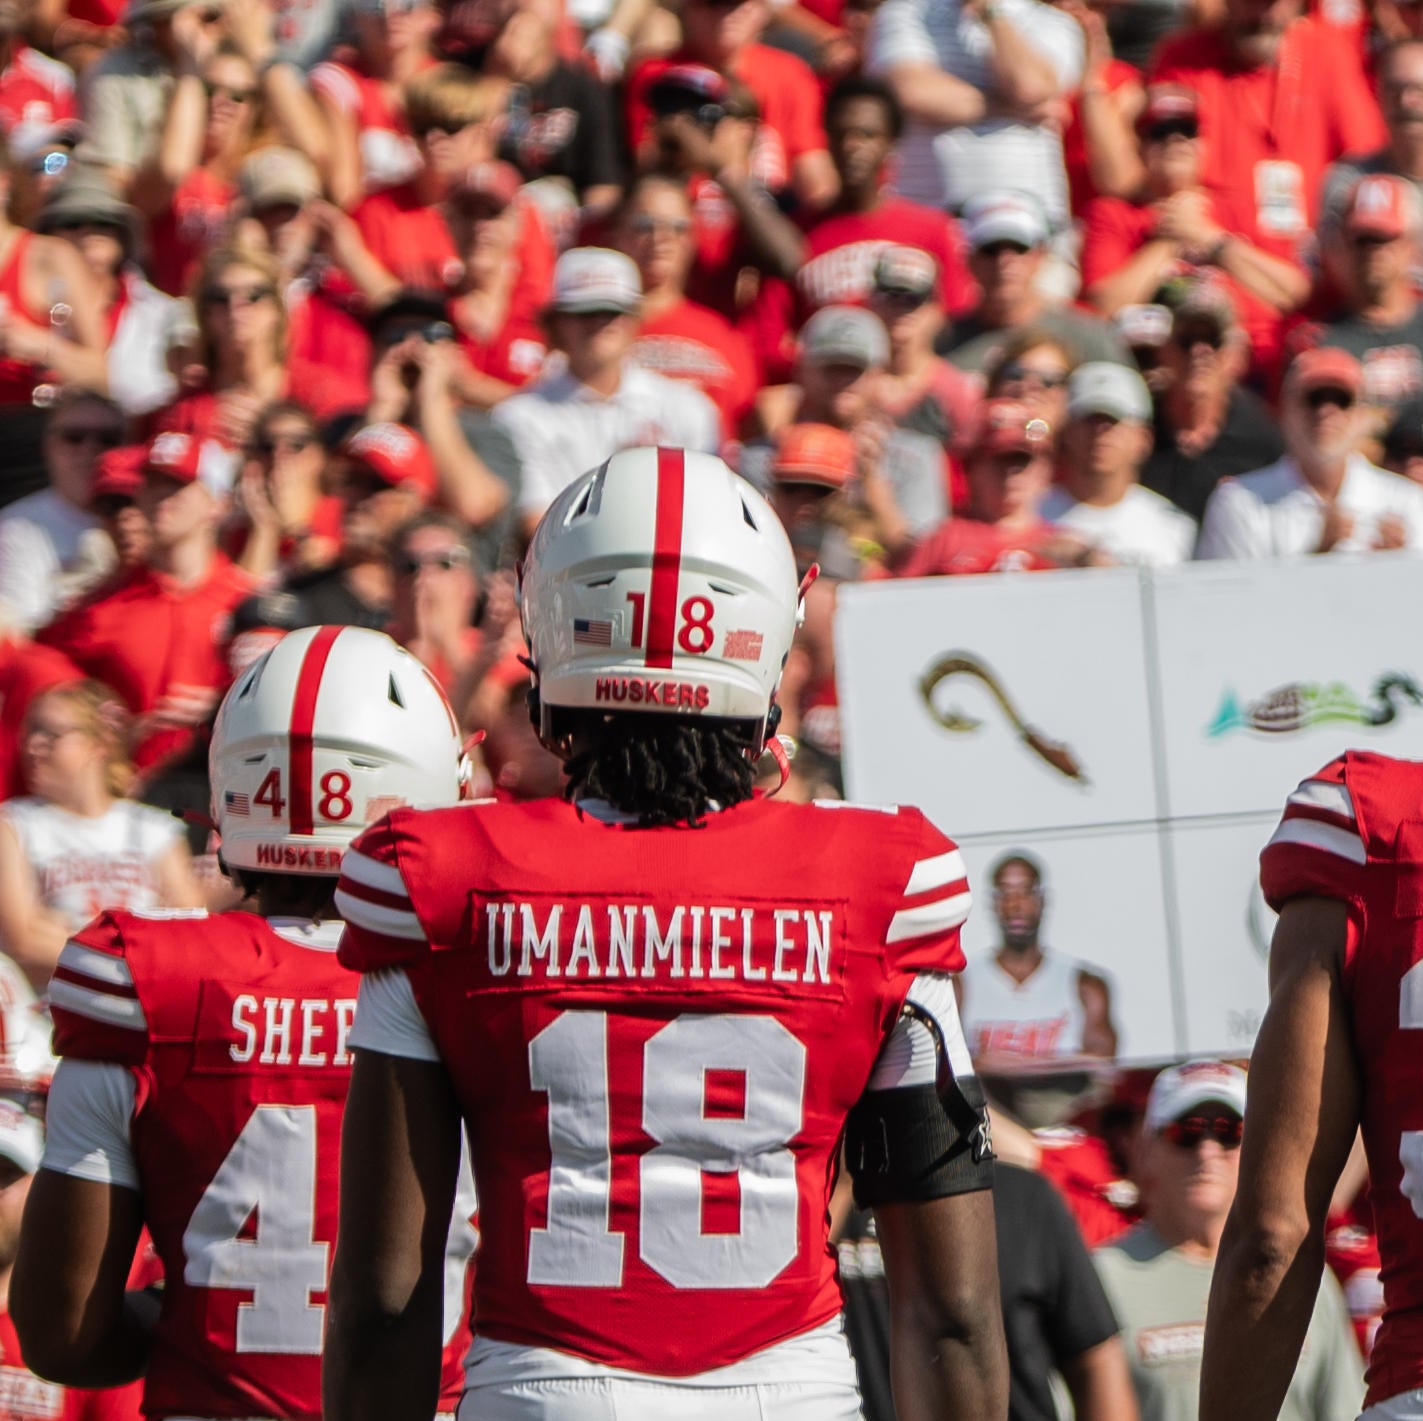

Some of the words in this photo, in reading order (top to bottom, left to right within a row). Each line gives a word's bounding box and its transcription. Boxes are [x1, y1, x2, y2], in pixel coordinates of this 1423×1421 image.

[627, 592, 715, 655] 18
[596, 676, 710, 710] HUSKERS
[252, 768, 353, 822] 48
[256, 844, 343, 871] HUSKER
[484, 902, 834, 985] UMANMIELEN
[525, 1008, 807, 1290] 18
